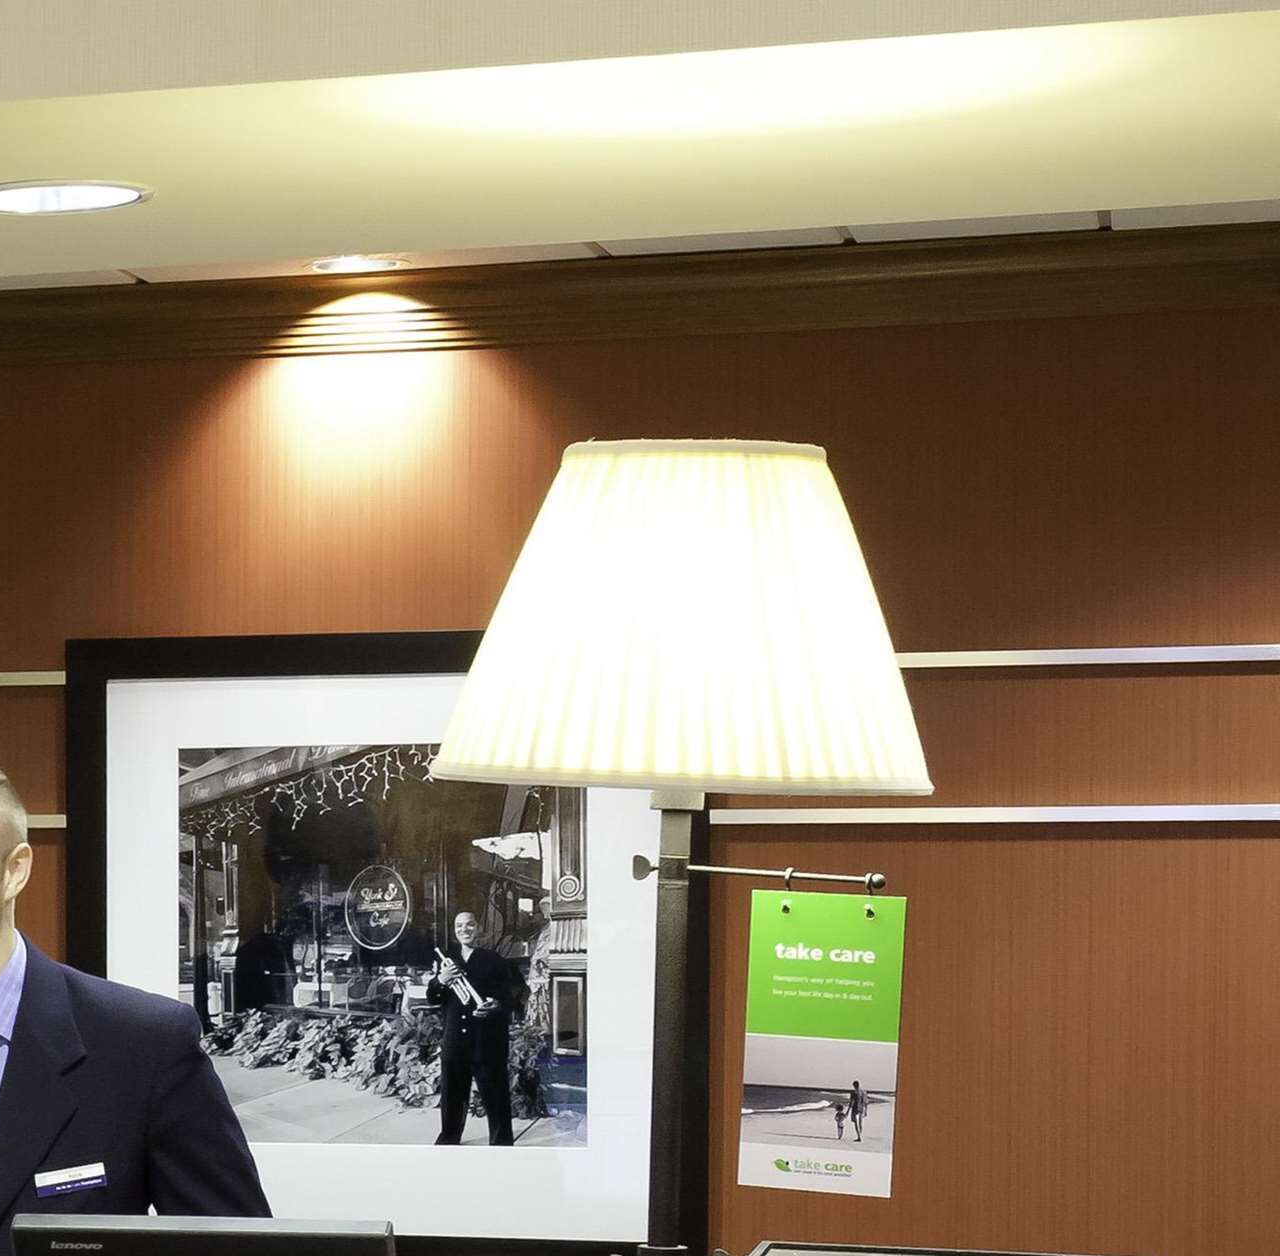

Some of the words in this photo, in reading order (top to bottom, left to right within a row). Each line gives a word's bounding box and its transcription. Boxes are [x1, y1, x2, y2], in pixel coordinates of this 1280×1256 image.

[774, 943, 824, 961] take
[829, 948, 877, 964] care
[794, 1159, 821, 1170] take
[824, 1162, 854, 1173] care
[50, 1240, 104, 1250] lenovo
